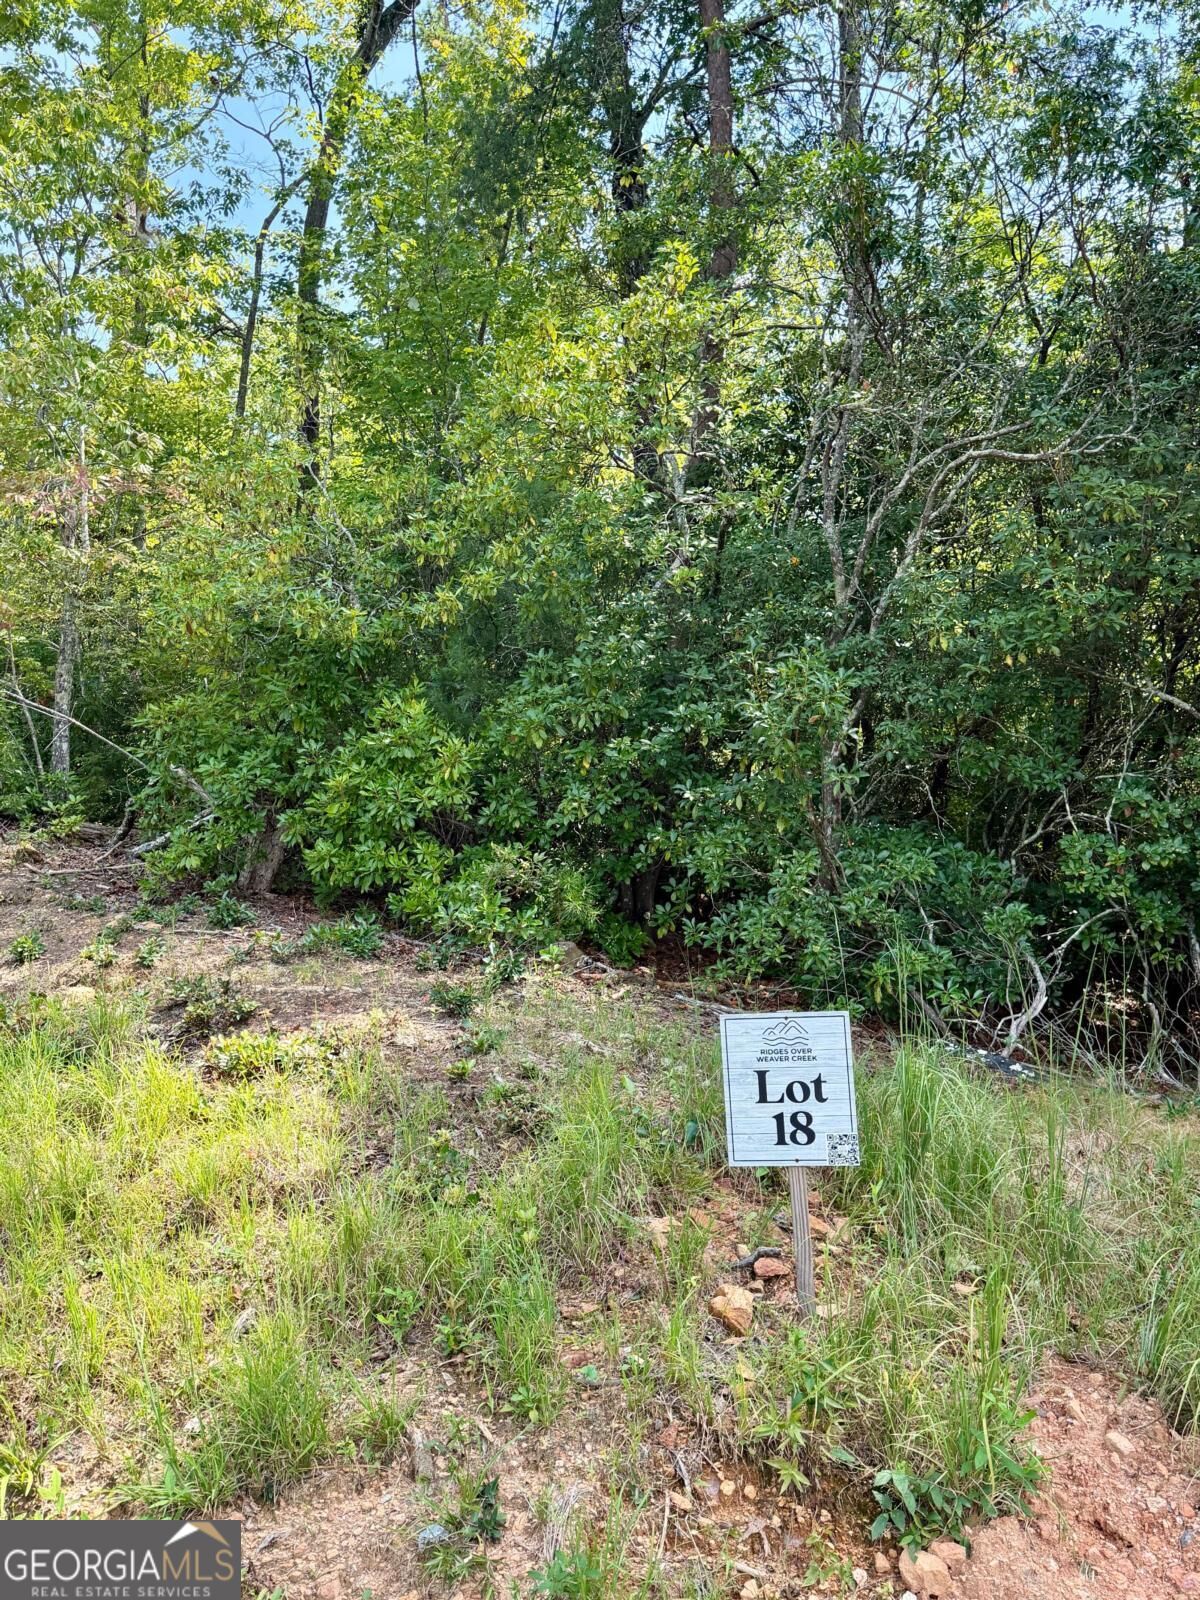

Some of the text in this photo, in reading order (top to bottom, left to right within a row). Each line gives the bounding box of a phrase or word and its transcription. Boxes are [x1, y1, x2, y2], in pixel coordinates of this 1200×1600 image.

[756, 1055, 790, 1063] WEAVER
[753, 1069, 829, 1104] Lot
[771, 1110, 816, 1146] 18
